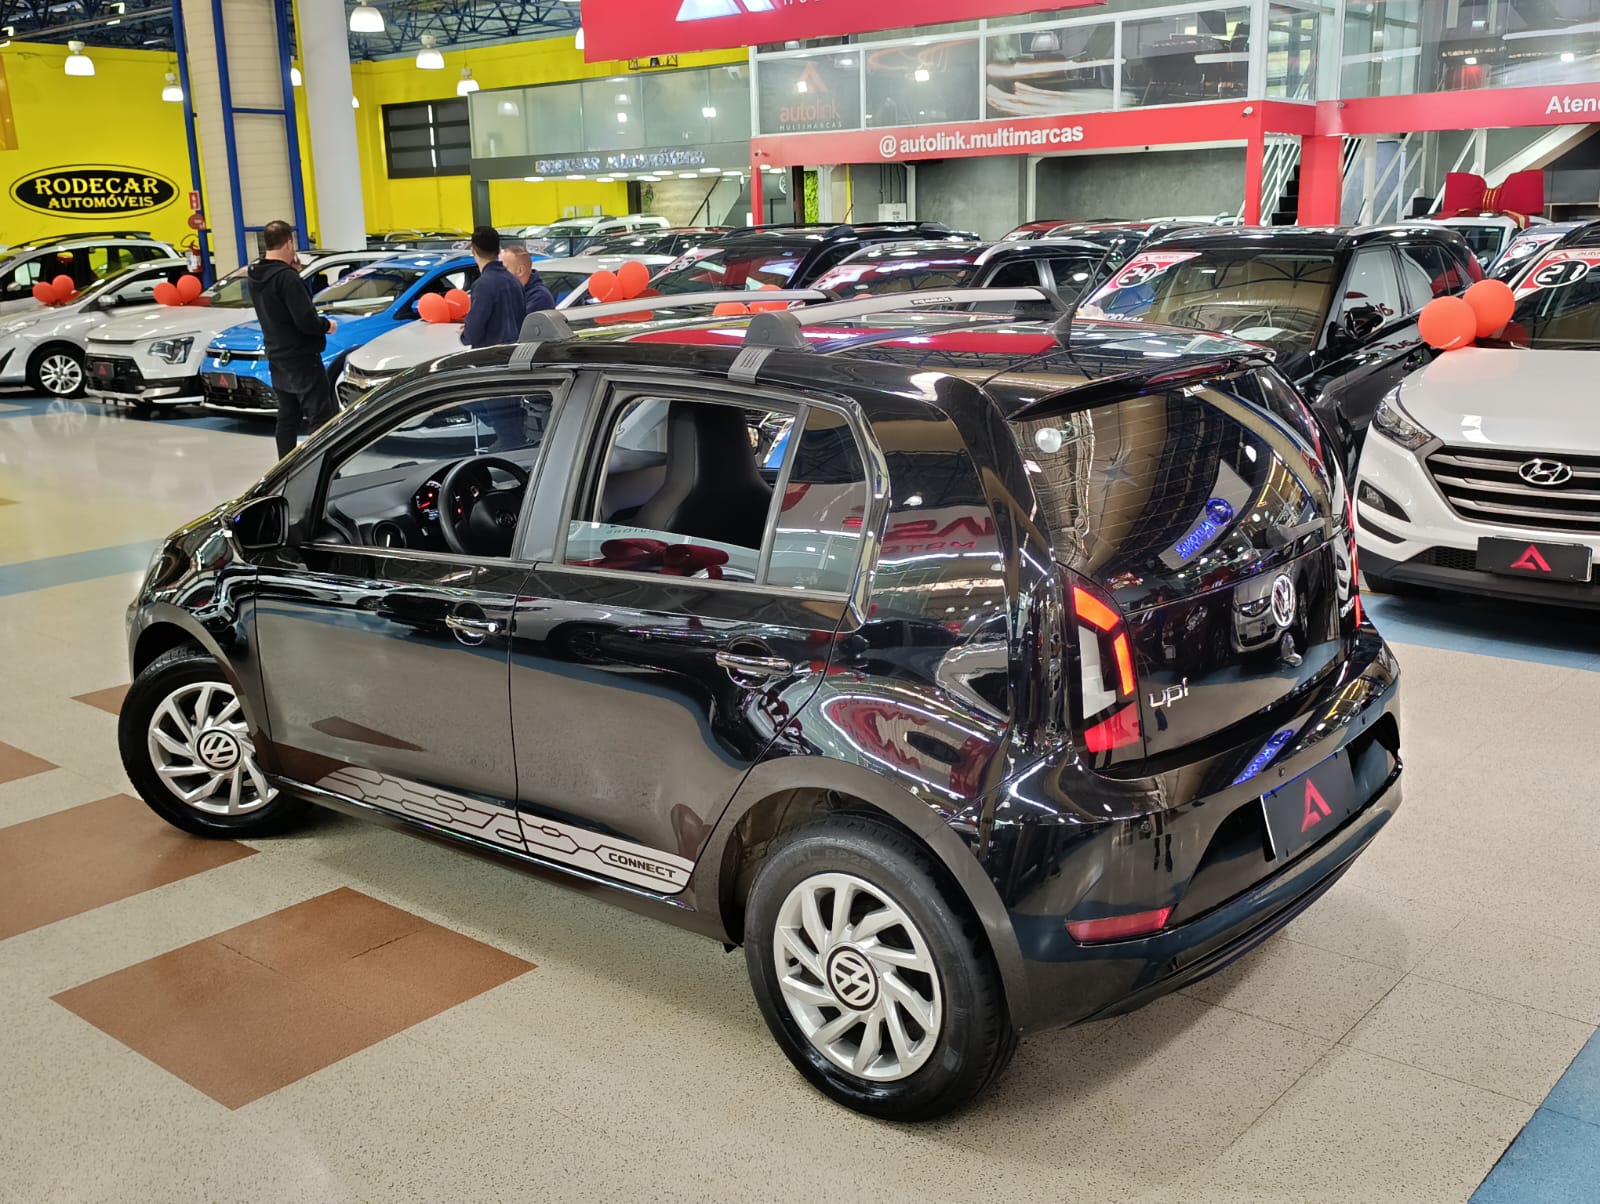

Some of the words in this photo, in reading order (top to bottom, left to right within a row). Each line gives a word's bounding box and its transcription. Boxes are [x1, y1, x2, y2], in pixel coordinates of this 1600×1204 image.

[779, 100, 841, 123] autolink
[1545, 95, 1600, 114] Aten
[779, 121, 842, 131] MULTIMARCAS
[879, 135, 897, 158] @
[900, 125, 1084, 153] autolink.multimarcas
[35, 178, 160, 195] RODECAR
[47, 194, 154, 209] AUTOMÓVEIS
[1119, 265, 1157, 283] 24
[1536, 264, 1586, 282] 21
[608, 852, 677, 878] CONNECT
